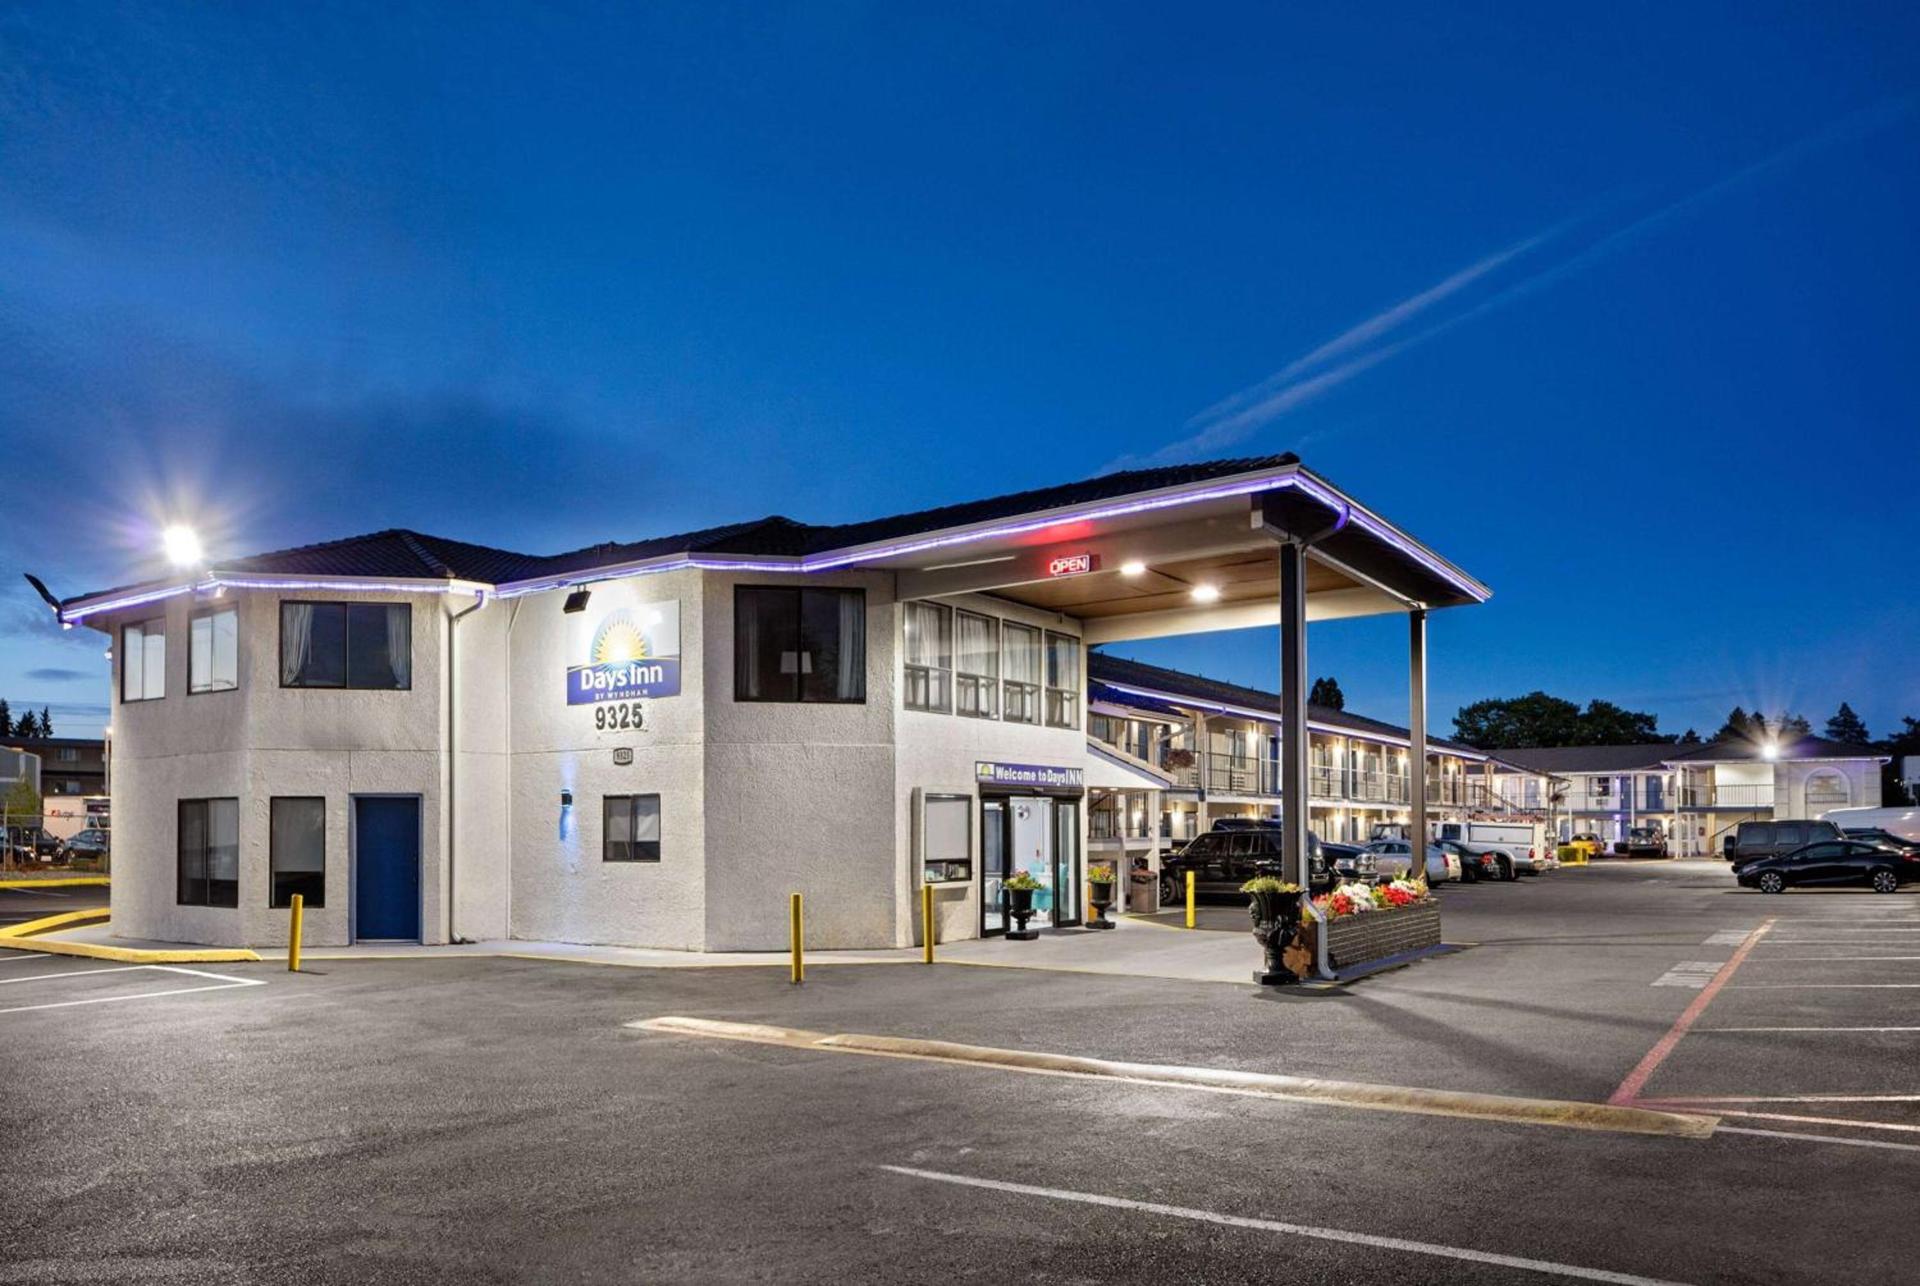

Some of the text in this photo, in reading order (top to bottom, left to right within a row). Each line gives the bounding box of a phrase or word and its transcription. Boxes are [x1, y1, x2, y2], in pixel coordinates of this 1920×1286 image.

[1050, 557, 1086, 574] OPEN
[581, 664, 663, 691] Days Inn
[607, 689, 648, 699] WYNDHAM
[595, 703, 643, 730] 9325
[995, 766, 1036, 781] Welcome
[1038, 769, 1046, 782] to
